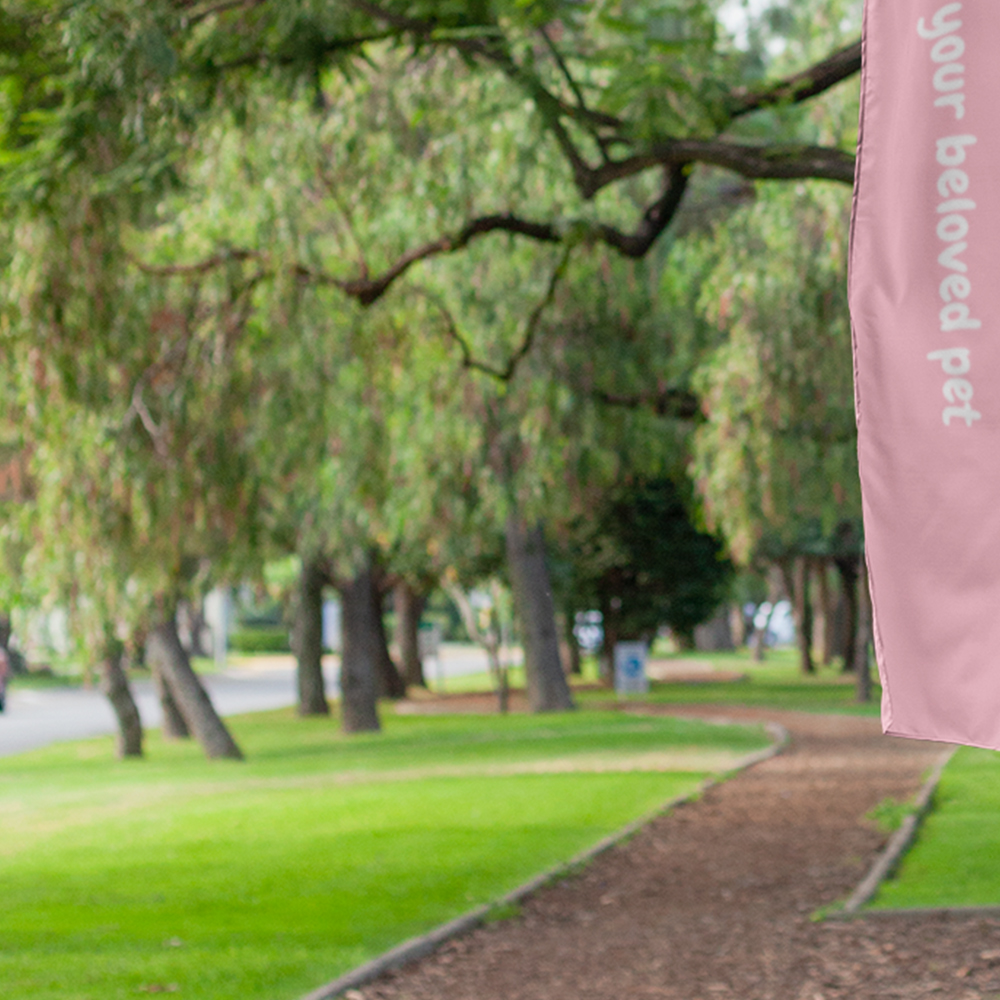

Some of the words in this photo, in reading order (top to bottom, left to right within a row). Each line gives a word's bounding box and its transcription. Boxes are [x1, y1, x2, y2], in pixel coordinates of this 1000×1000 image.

[916, 2, 965, 119] your
[936, 134, 982, 332] beloved
[926, 347, 981, 427] pet
